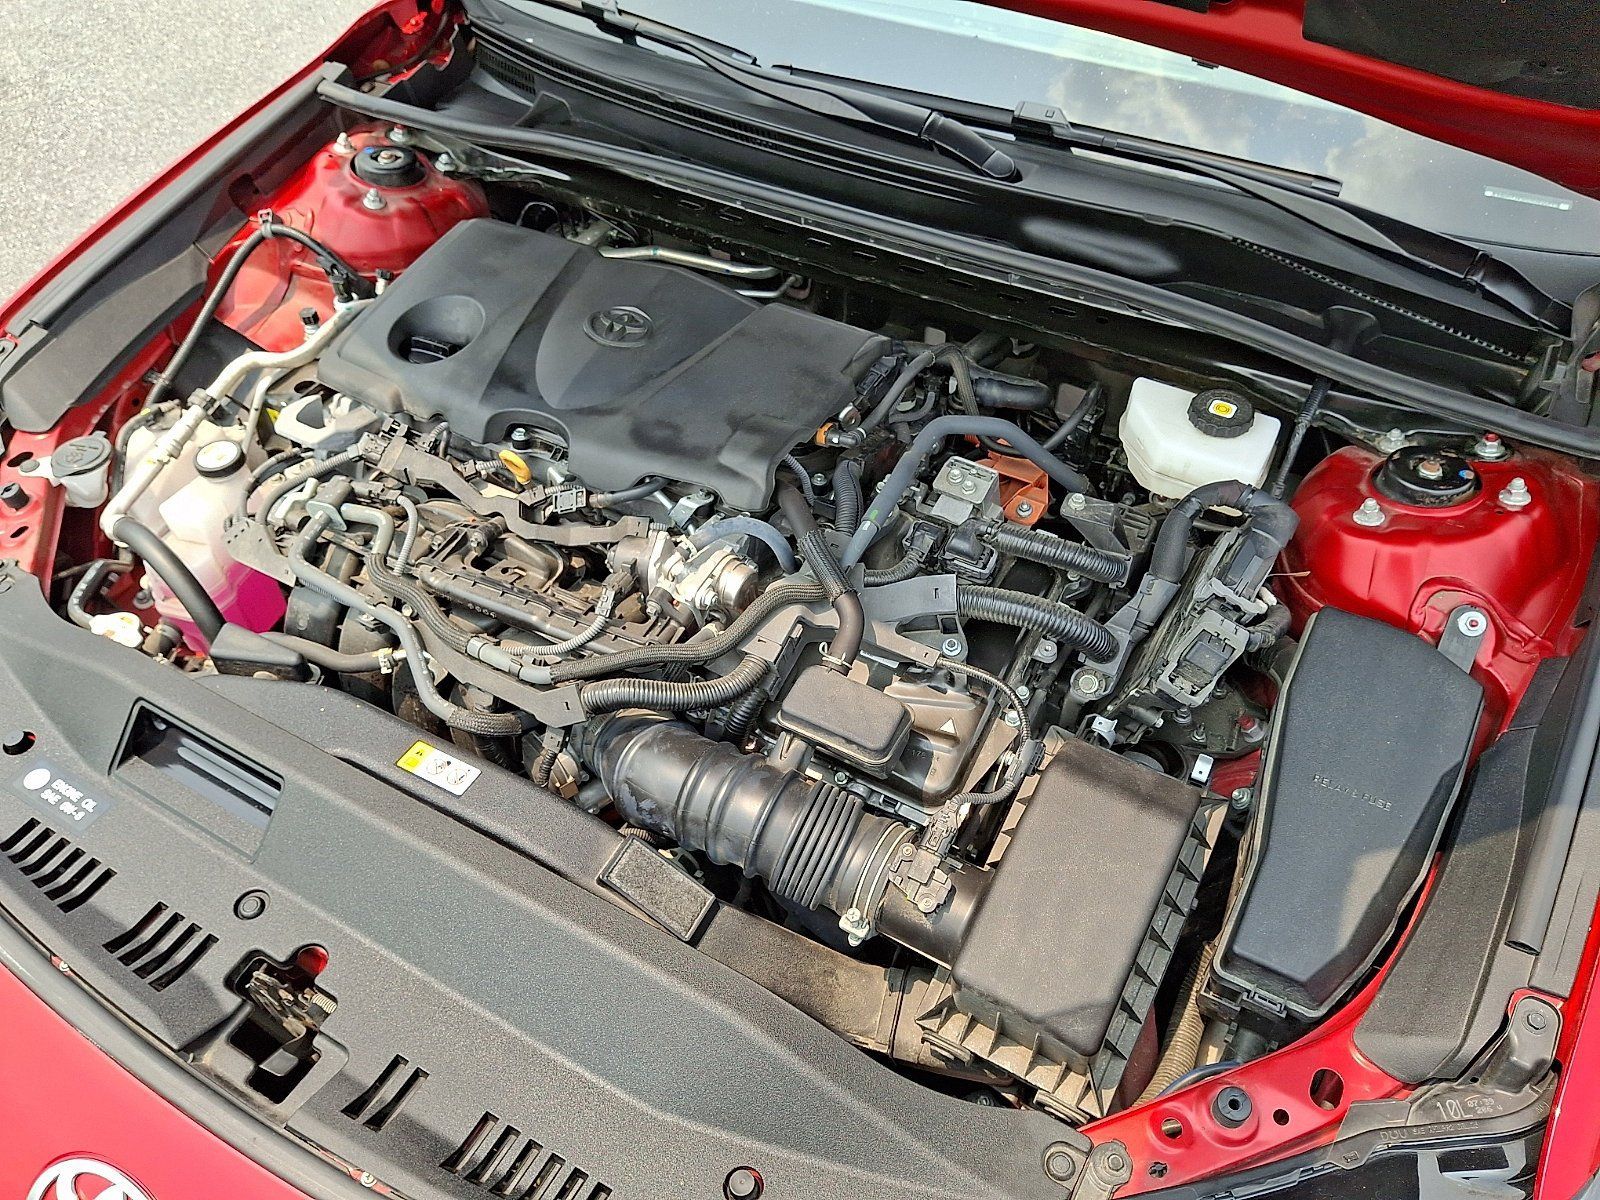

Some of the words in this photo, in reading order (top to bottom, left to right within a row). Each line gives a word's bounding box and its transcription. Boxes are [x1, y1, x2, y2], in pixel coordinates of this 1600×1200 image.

[41, 789, 62, 805] SAE
[51, 779, 83, 803] ENGINE
[81, 799, 98, 813] OIL
[1362, 793, 1392, 812] FUSE
